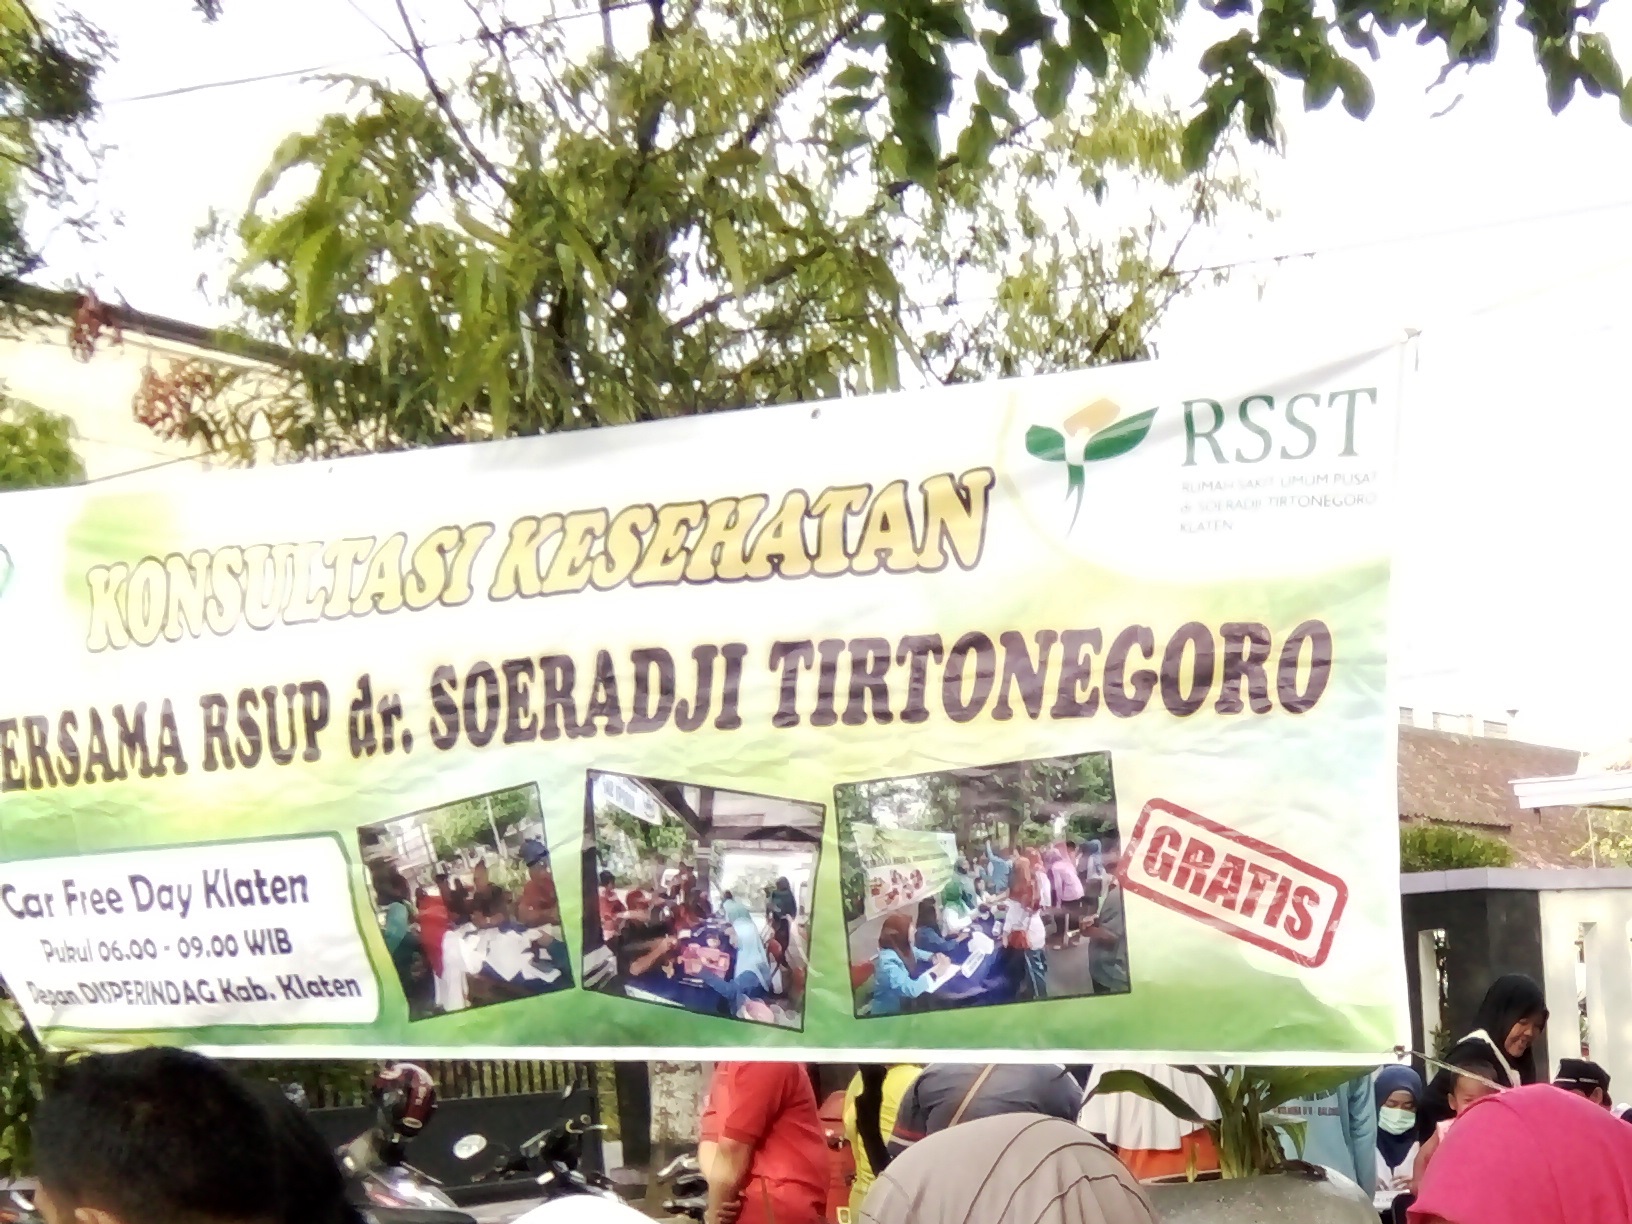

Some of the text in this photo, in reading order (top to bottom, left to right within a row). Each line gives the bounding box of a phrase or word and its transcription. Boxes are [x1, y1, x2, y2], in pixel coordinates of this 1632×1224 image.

[1181, 387, 1378, 467] RSST
[1268, 492, 1378, 509] TIRTONEGORO
[1280, 472, 1329, 488] UMUM
[1179, 518, 1233, 534] KLATEN
[87, 466, 996, 653] KONSULTASI KESEHATAN
[0, 618, 1334, 793] ERSAMA RSUP dr. SOERADJI TIRTONEGORO
[1, 868, 311, 920] Car Free Day Klaten
[1141, 823, 1322, 941] GRATIS
[97, 937, 158, 963] 06.00
[177, 934, 240, 959] 09.00
[243, 927, 295, 957] WIB
[77, 977, 216, 1006] DISPERINDAG
[217, 976, 276, 1003] Kab.
[275, 973, 363, 1001] Klaten
